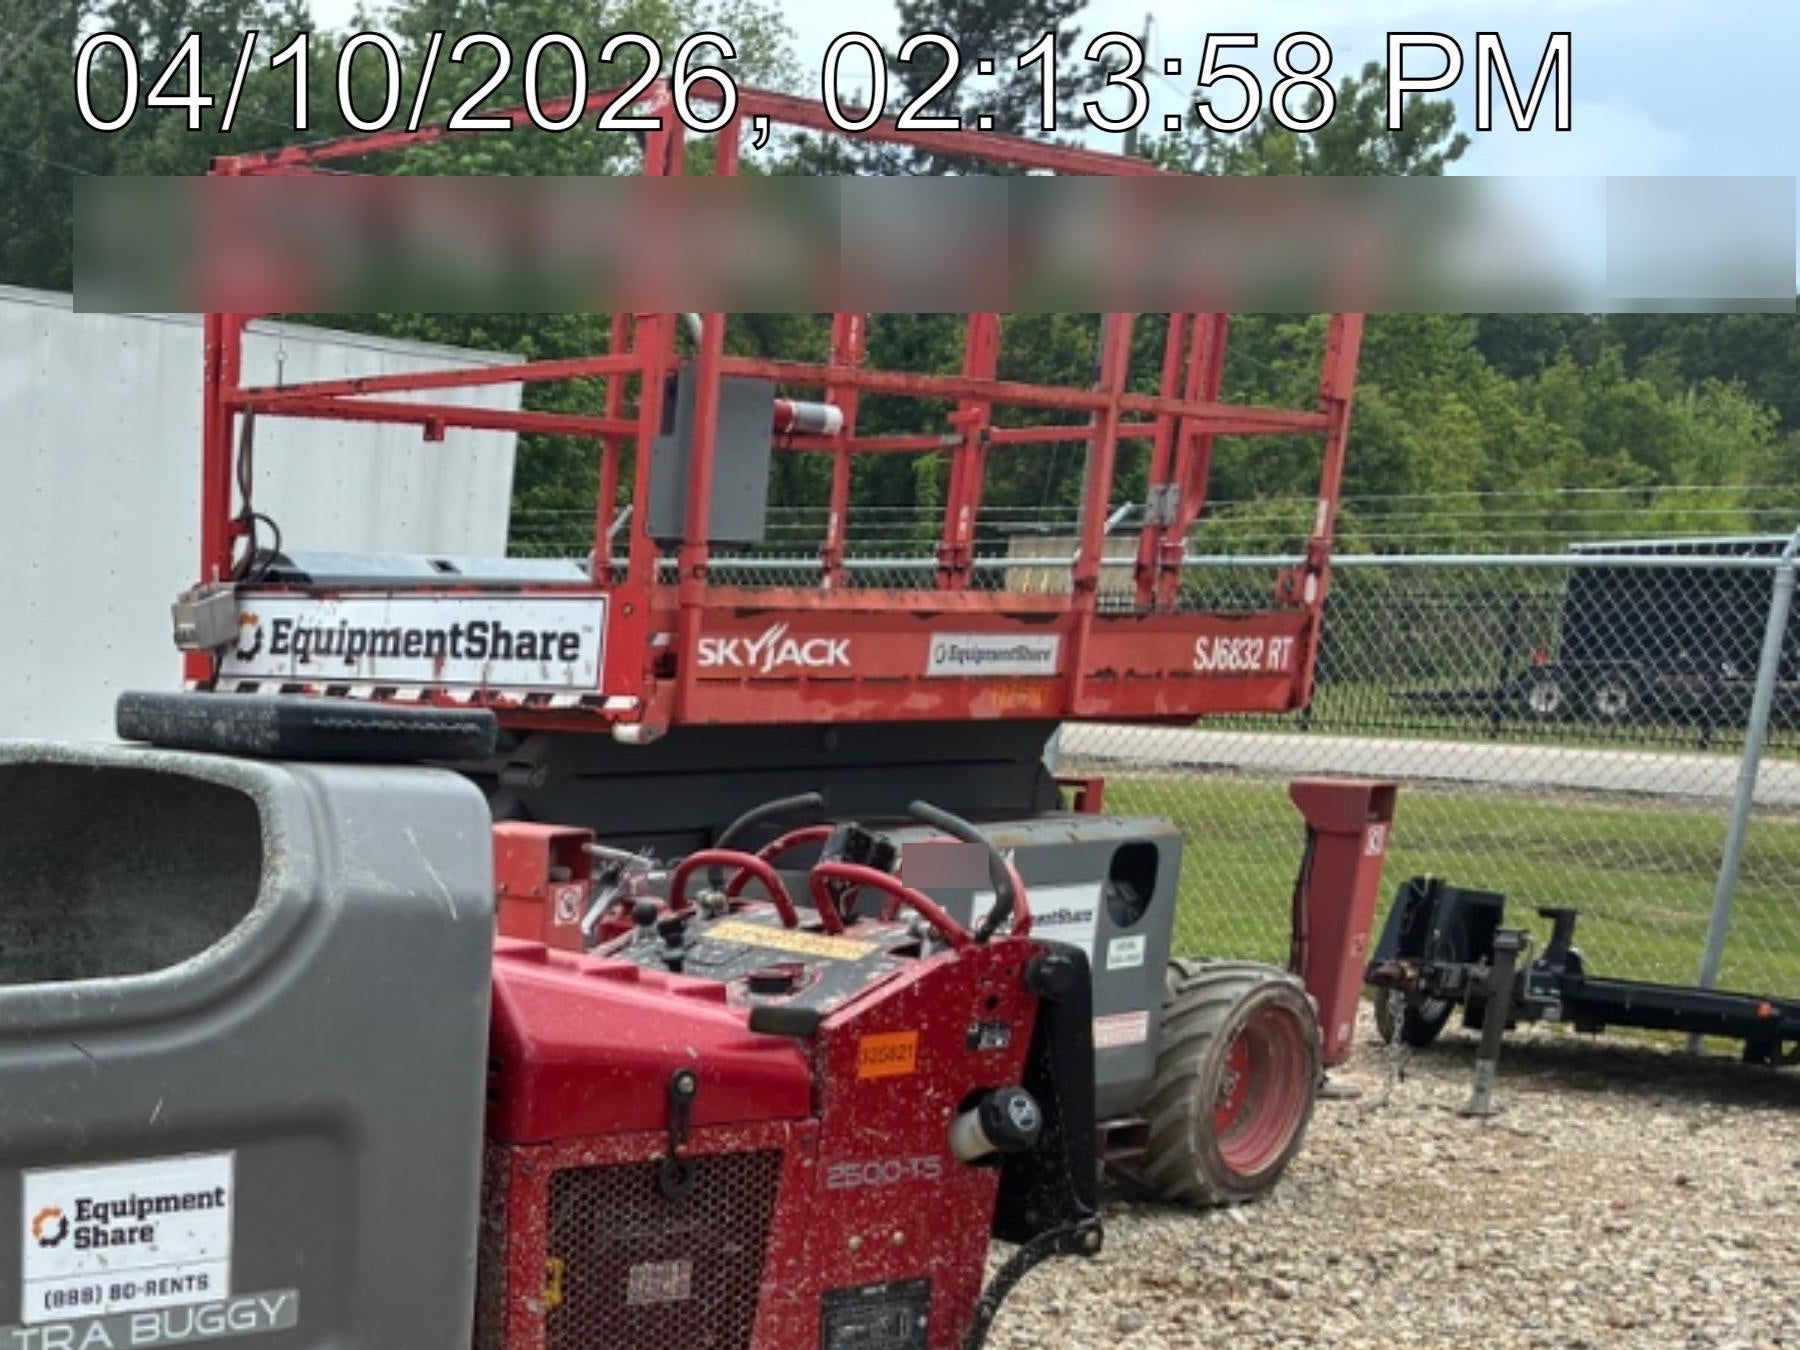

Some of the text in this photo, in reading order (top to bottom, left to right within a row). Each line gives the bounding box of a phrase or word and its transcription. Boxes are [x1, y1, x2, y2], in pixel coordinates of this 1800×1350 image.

[269, 616, 581, 666] EquipmentShare
[697, 622, 852, 673] SKYJACK
[1193, 635, 1294, 670] SJ6832 RT
[74, 1186, 226, 1224] Equipment
[74, 1223, 155, 1250] Share
[44, 1284, 102, 1310] (888)
[131, 1294, 287, 1345] BUGGY
